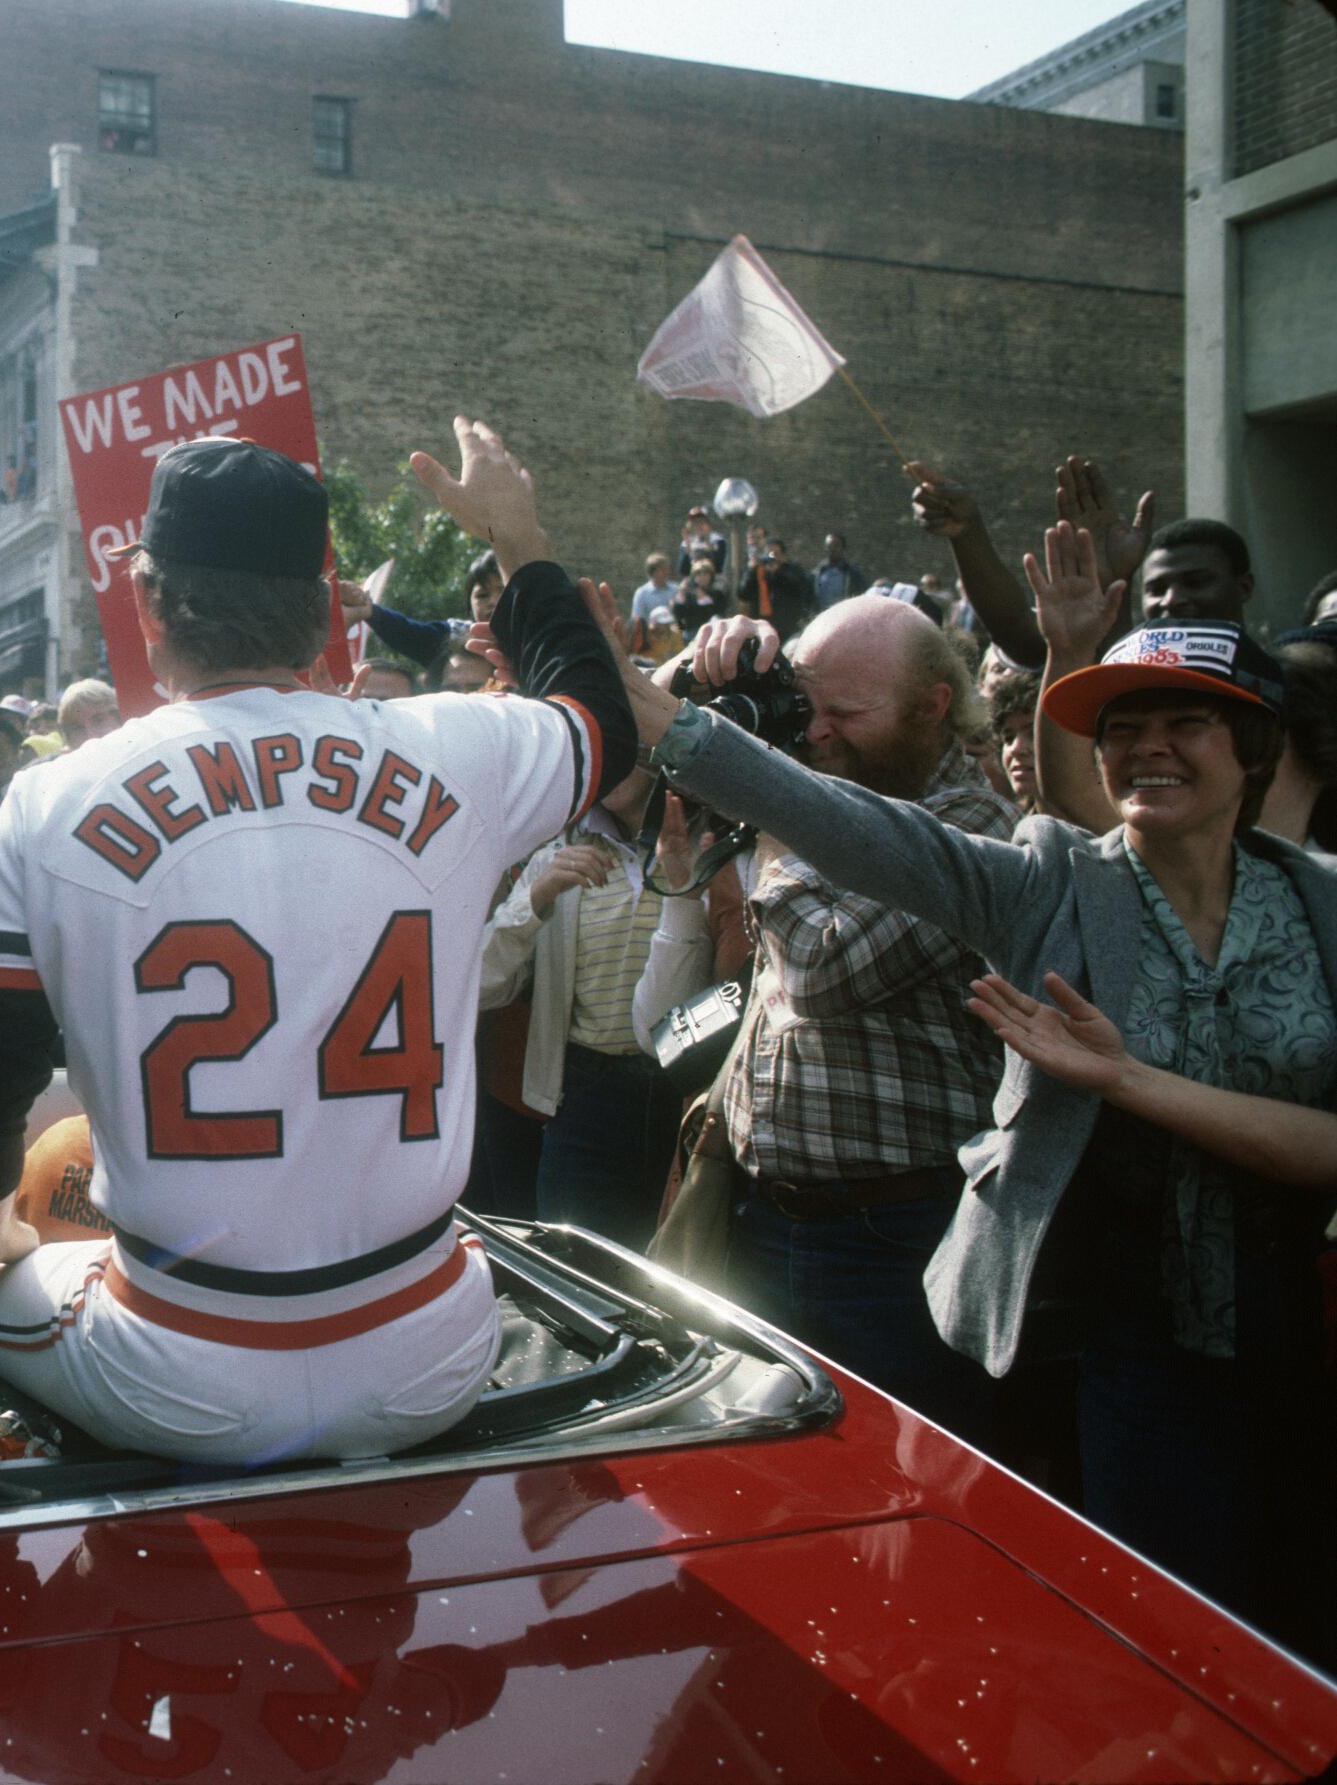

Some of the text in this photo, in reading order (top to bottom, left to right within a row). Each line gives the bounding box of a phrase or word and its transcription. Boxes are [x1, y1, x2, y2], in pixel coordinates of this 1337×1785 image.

[66, 386, 152, 453] WE
[164, 338, 302, 430] MADE
[1186, 642, 1228, 655] ORIOLES
[72, 733, 460, 884] DEMPSEY
[133, 909, 444, 1161] 24
